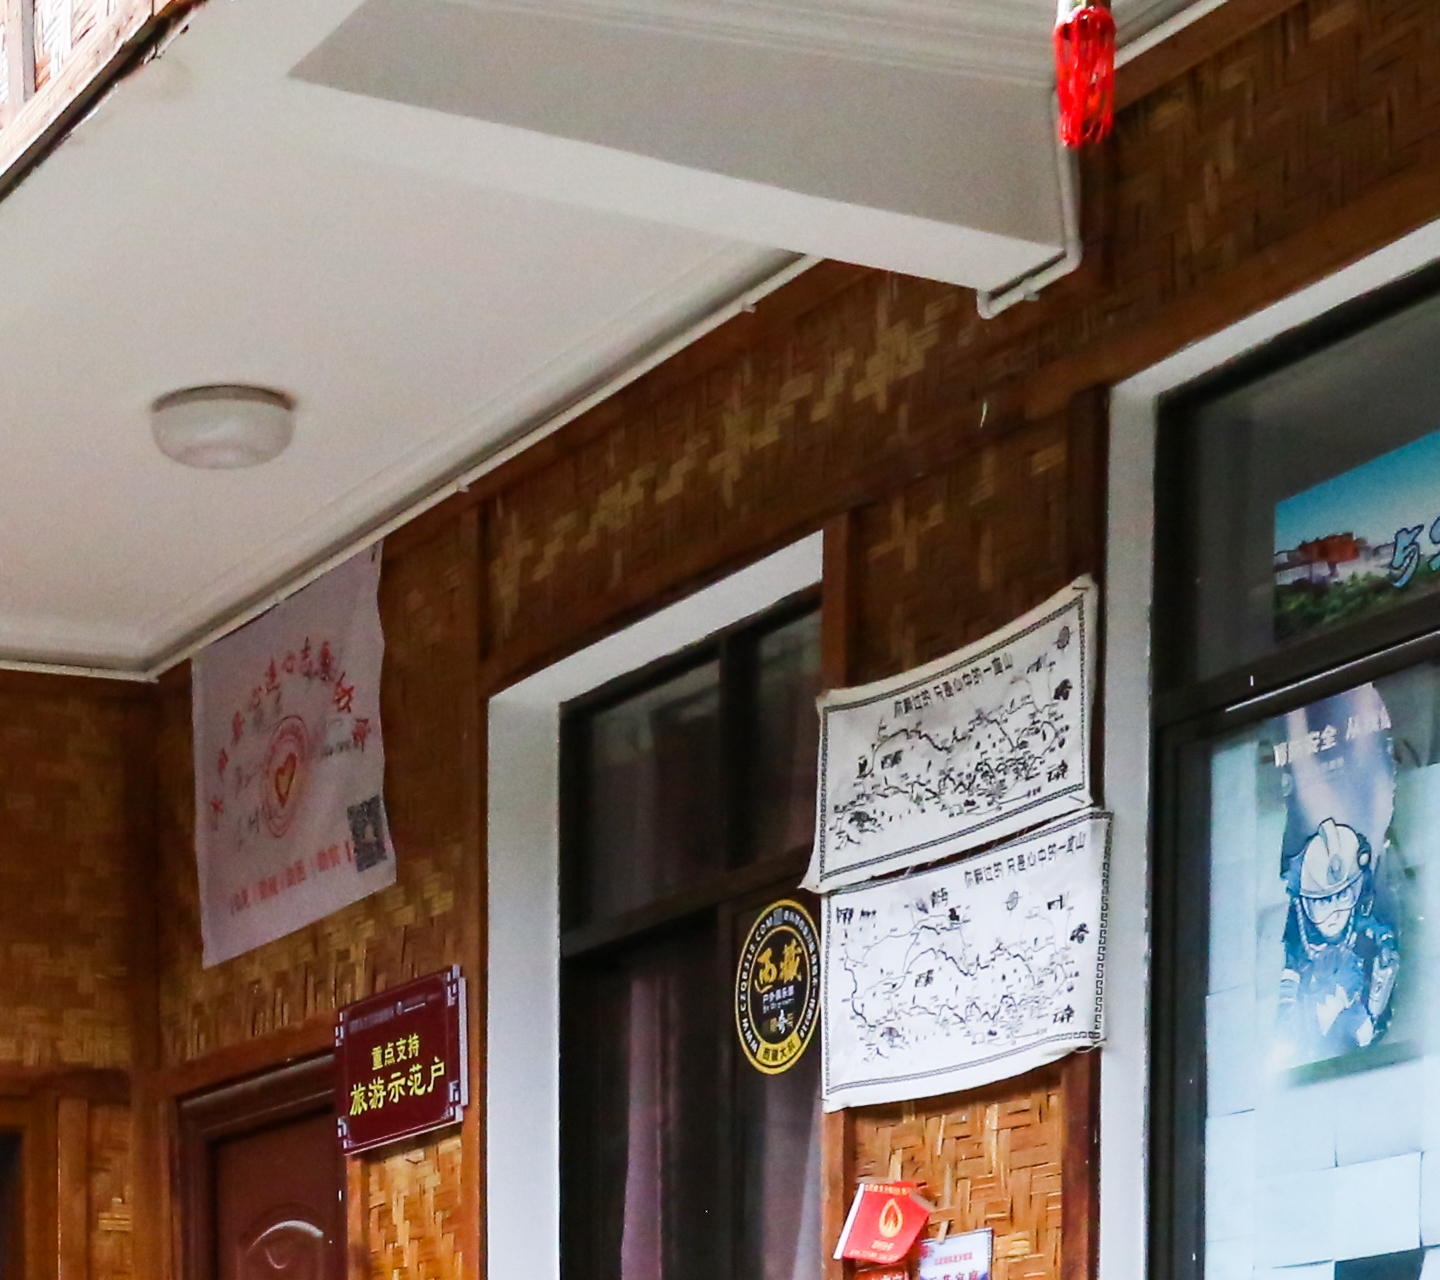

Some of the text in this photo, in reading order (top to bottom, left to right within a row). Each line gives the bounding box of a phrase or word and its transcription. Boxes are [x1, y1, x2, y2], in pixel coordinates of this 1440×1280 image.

[371, 1033, 420, 1071] 重点支持
[349, 1056, 446, 1116] 旅游示范户
